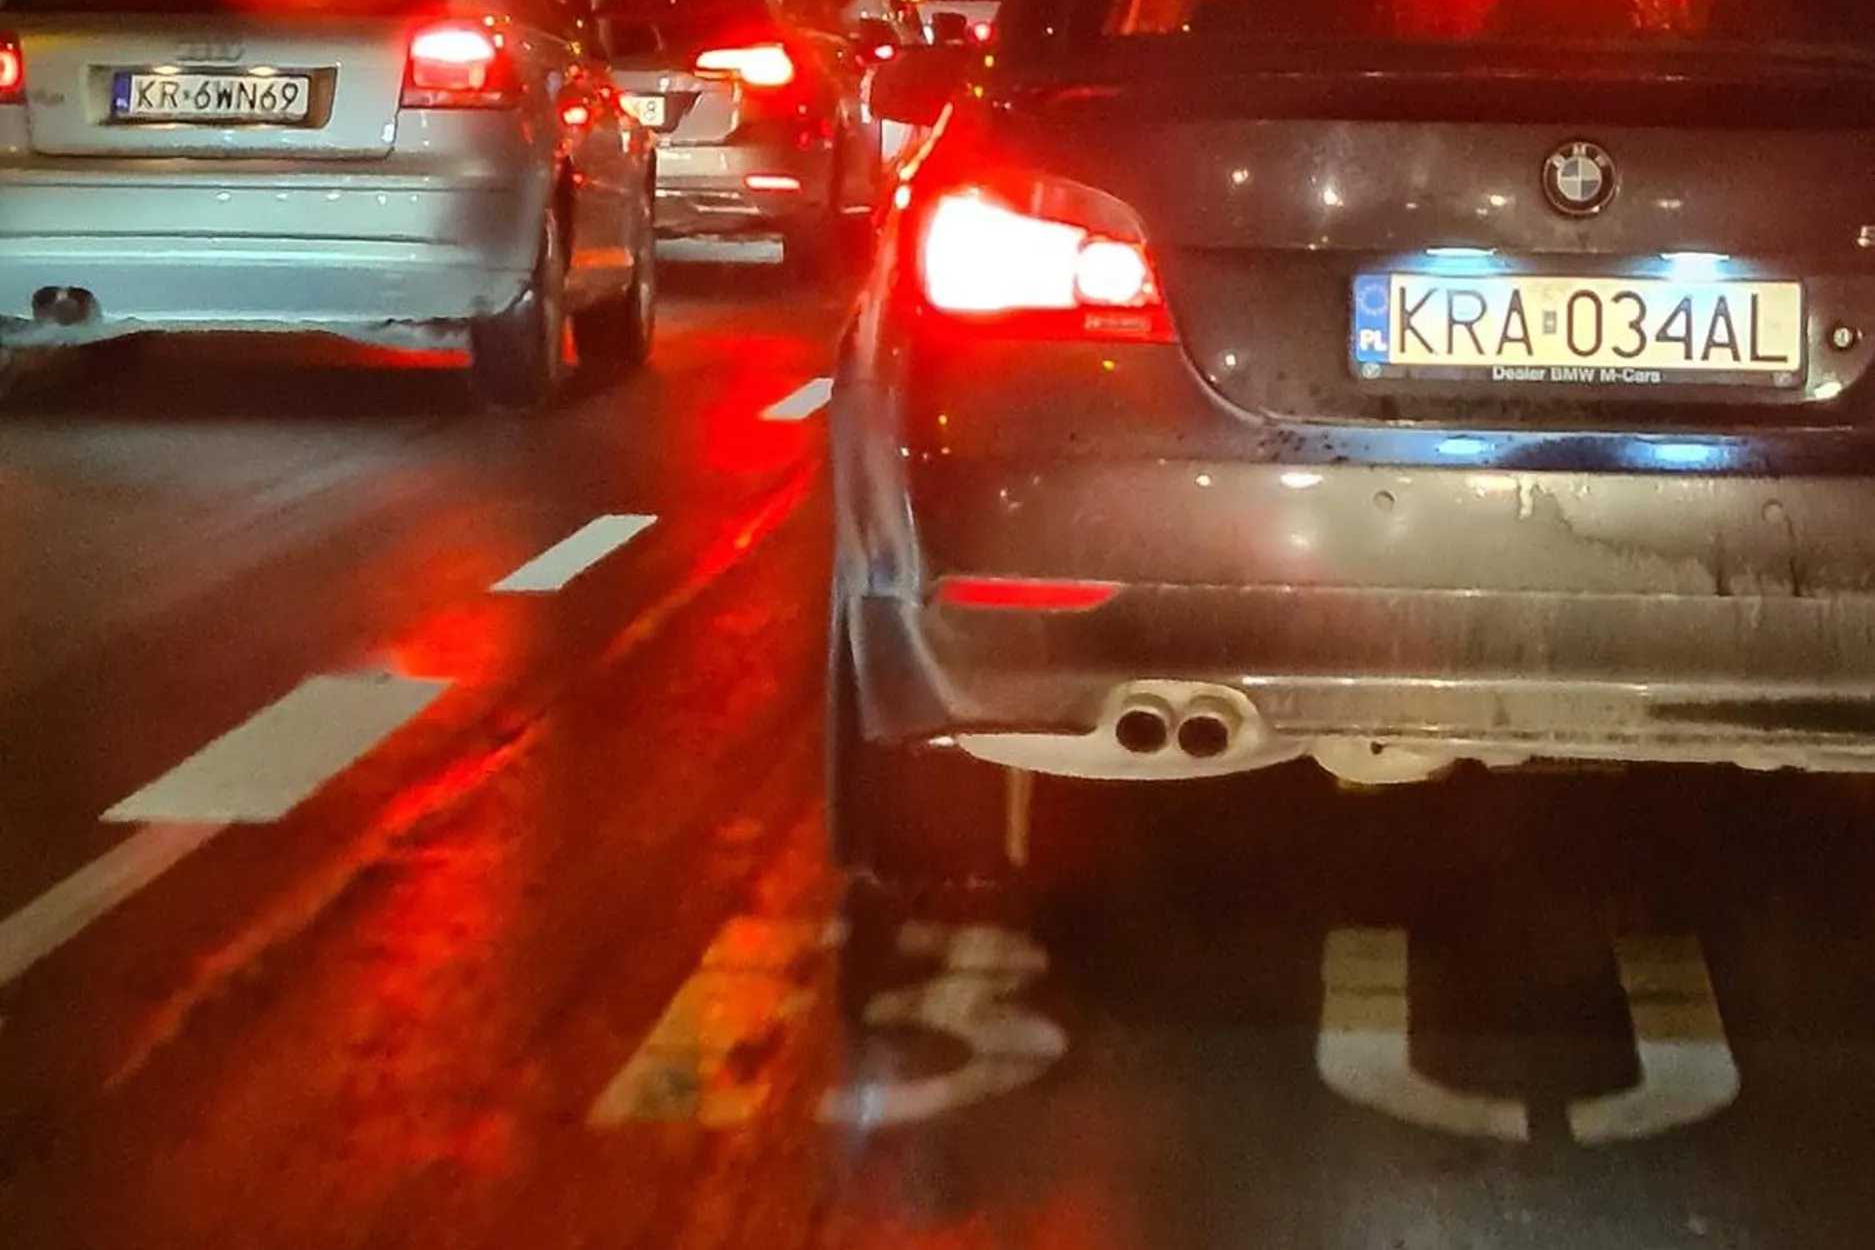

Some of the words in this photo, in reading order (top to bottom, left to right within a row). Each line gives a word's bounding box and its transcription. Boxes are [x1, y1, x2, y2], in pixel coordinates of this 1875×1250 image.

[136, 80, 181, 108] KR
[194, 81, 300, 111] 6WN69
[1398, 285, 1534, 356] KRA
[1564, 289, 1789, 364] 034AL
[1359, 328, 1388, 352] PL
[1491, 365, 1546, 381] Dealer
[1550, 367, 1595, 382] BMW
[1599, 367, 1662, 383] M-Cars
